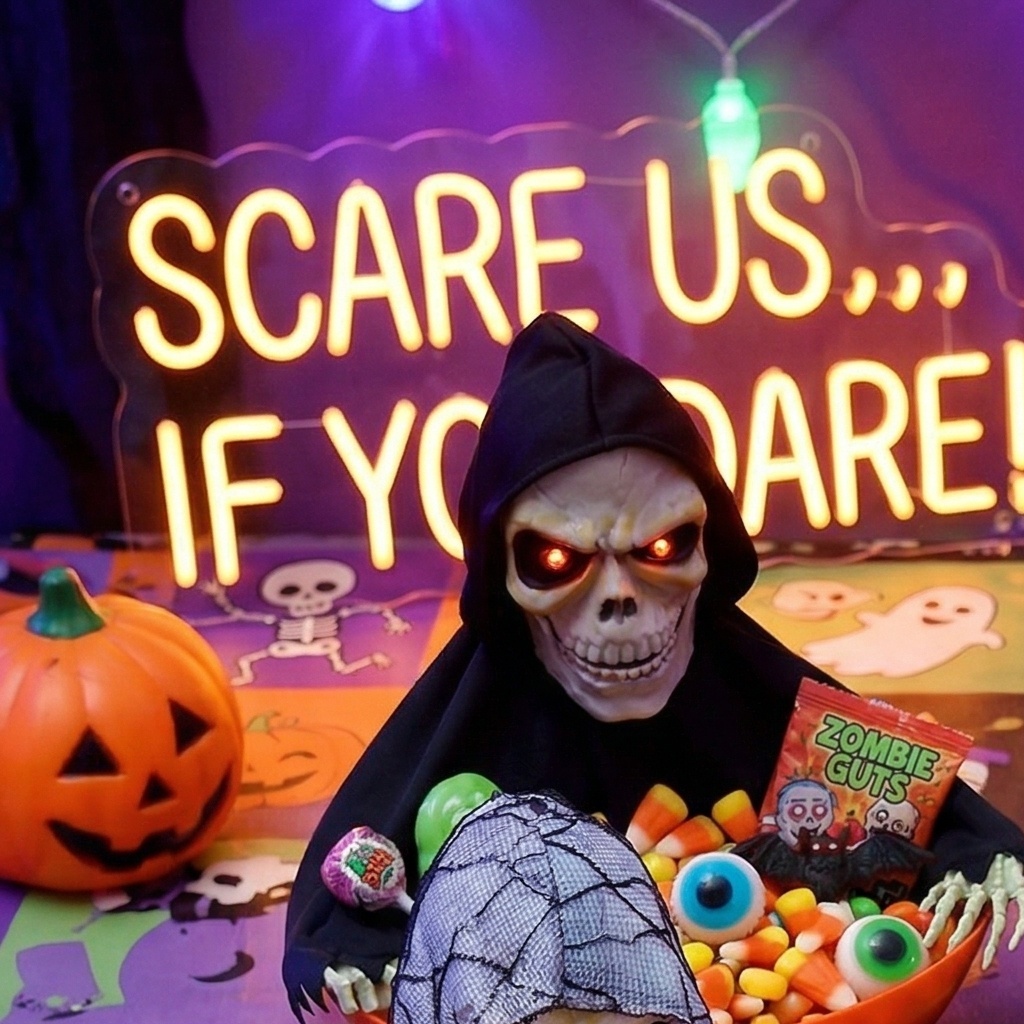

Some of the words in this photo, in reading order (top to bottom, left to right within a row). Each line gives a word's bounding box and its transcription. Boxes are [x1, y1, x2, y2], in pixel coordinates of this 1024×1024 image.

[128, 166, 600, 371] SCARE
[154, 413, 284, 590] IF
[815, 714, 941, 782] ZOMBIE
[825, 752, 911, 805] GUTS
